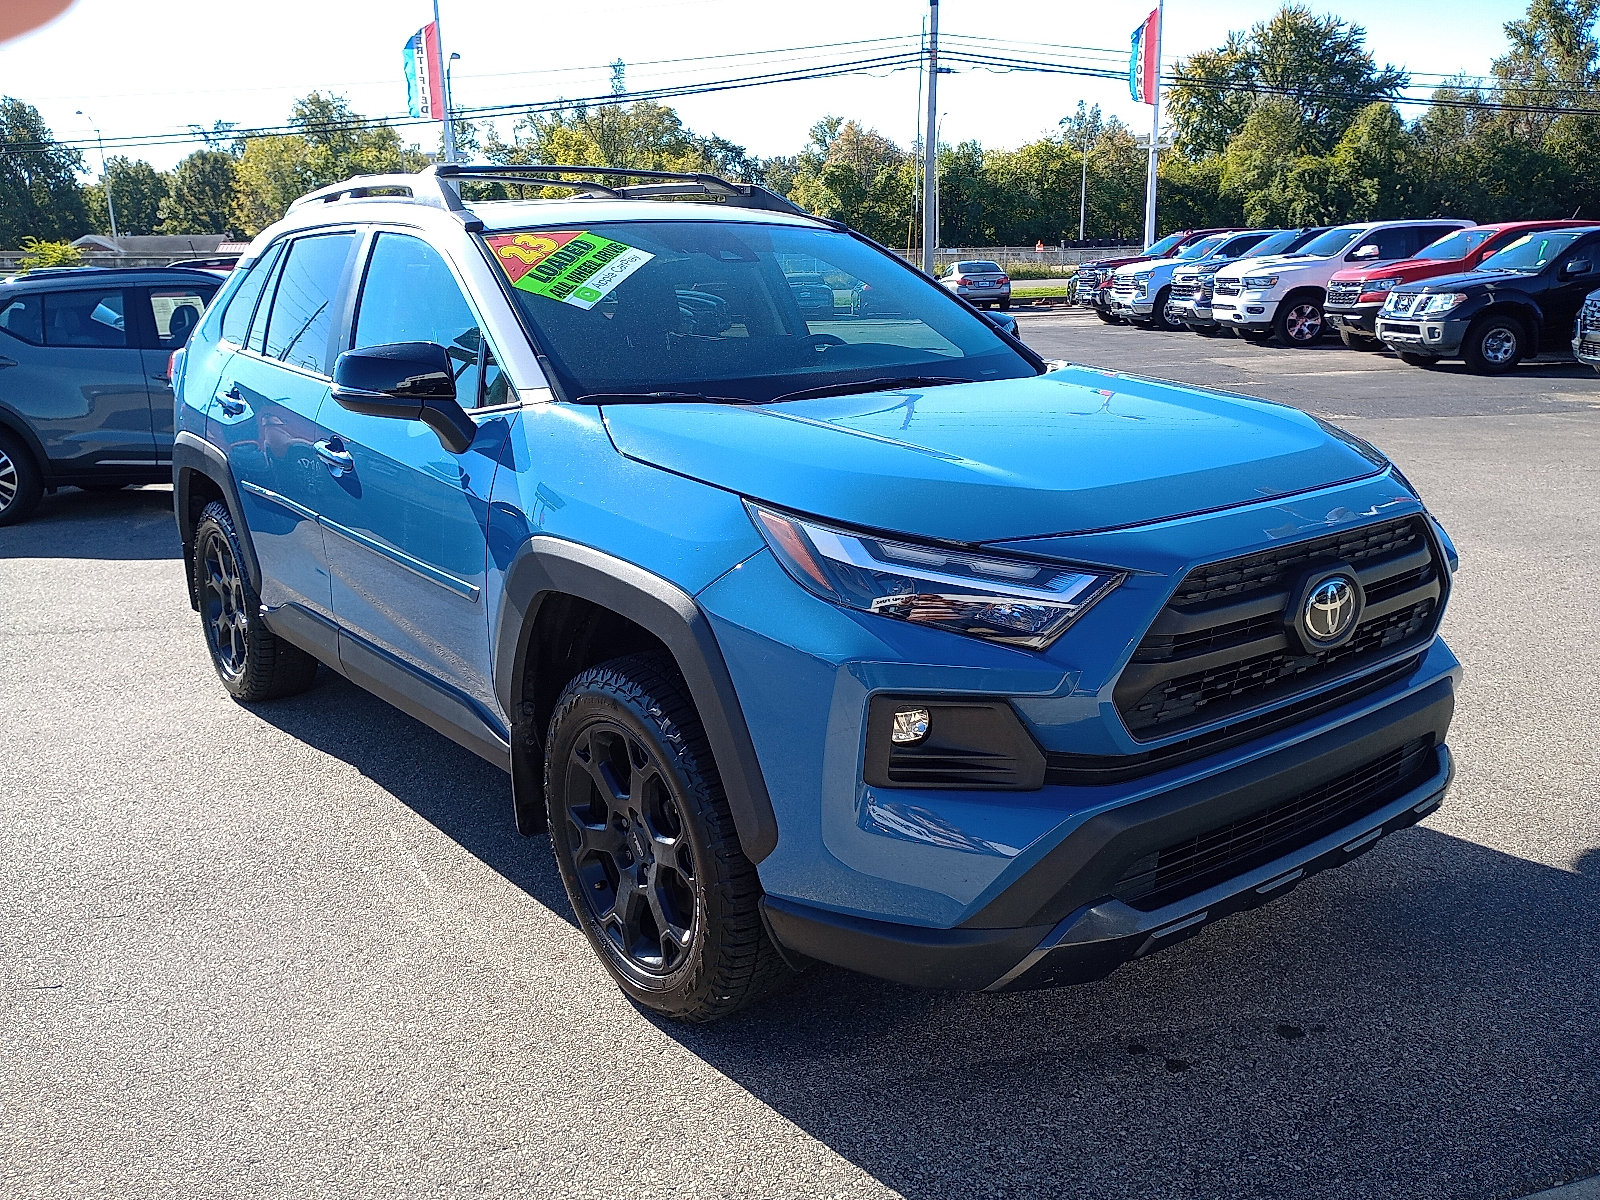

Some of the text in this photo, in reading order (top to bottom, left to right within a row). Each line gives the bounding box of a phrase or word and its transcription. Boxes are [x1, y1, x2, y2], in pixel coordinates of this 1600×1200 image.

[497, 234, 559, 265] 23
[527, 239, 597, 284] LOADED
[549, 242, 629, 300] ALL WHEEL DRIVE
[592, 254, 642, 289] Apple CarPlay
